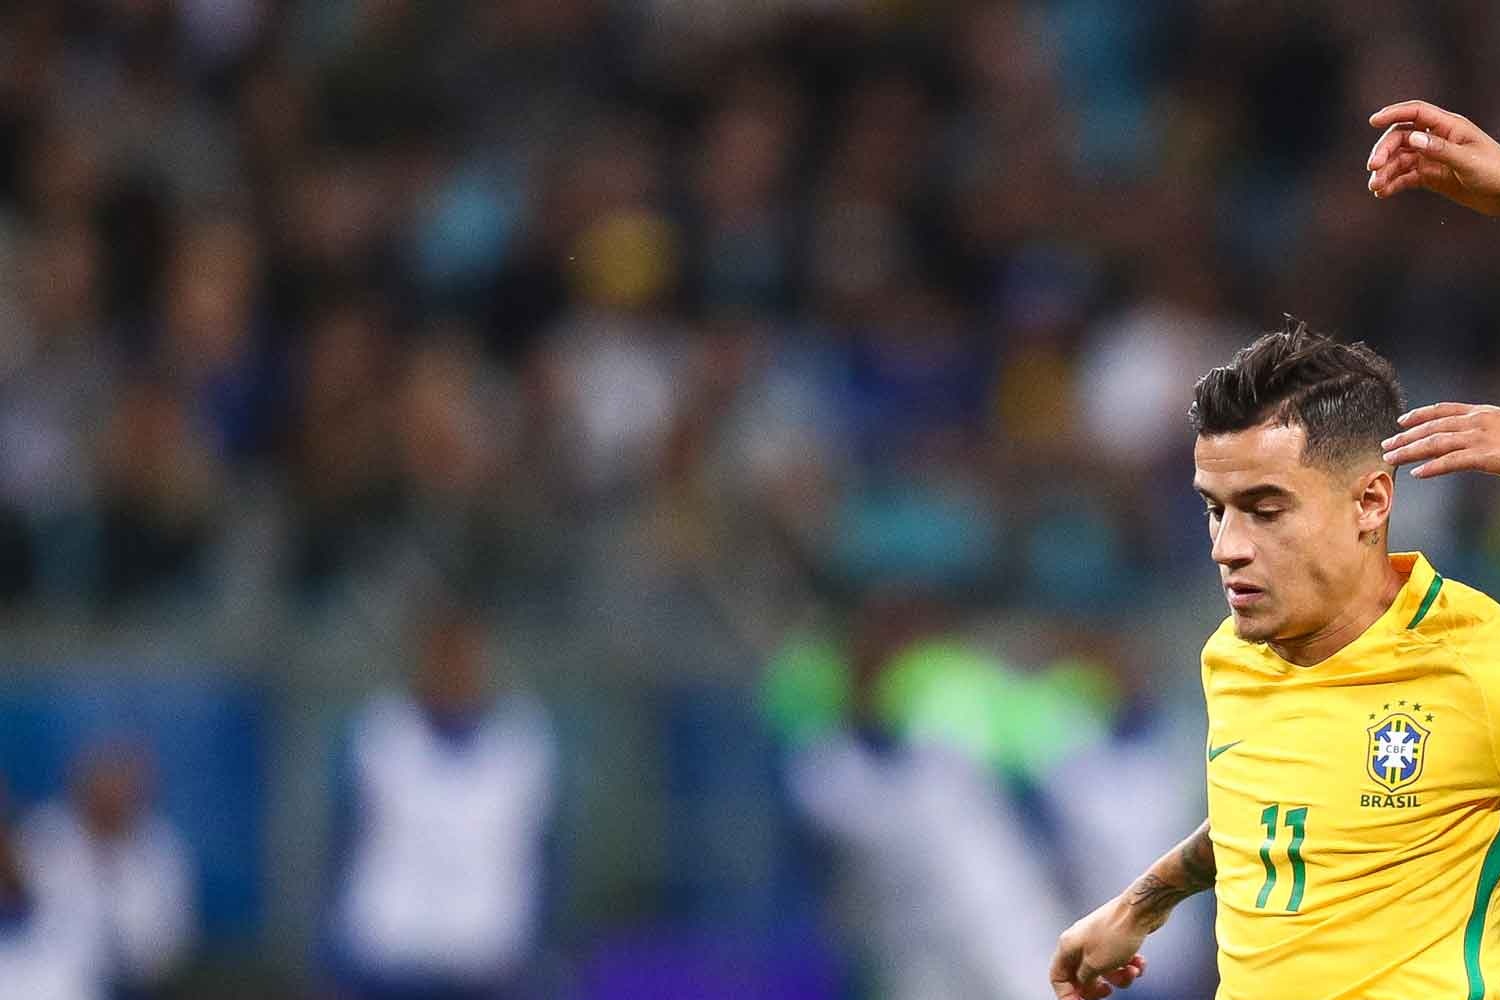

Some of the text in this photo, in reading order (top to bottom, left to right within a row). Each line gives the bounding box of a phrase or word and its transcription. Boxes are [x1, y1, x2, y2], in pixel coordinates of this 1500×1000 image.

[1386, 744, 1407, 754] CBF
[1361, 794, 1421, 808] BRASIL
[1256, 804, 1308, 912] 11
